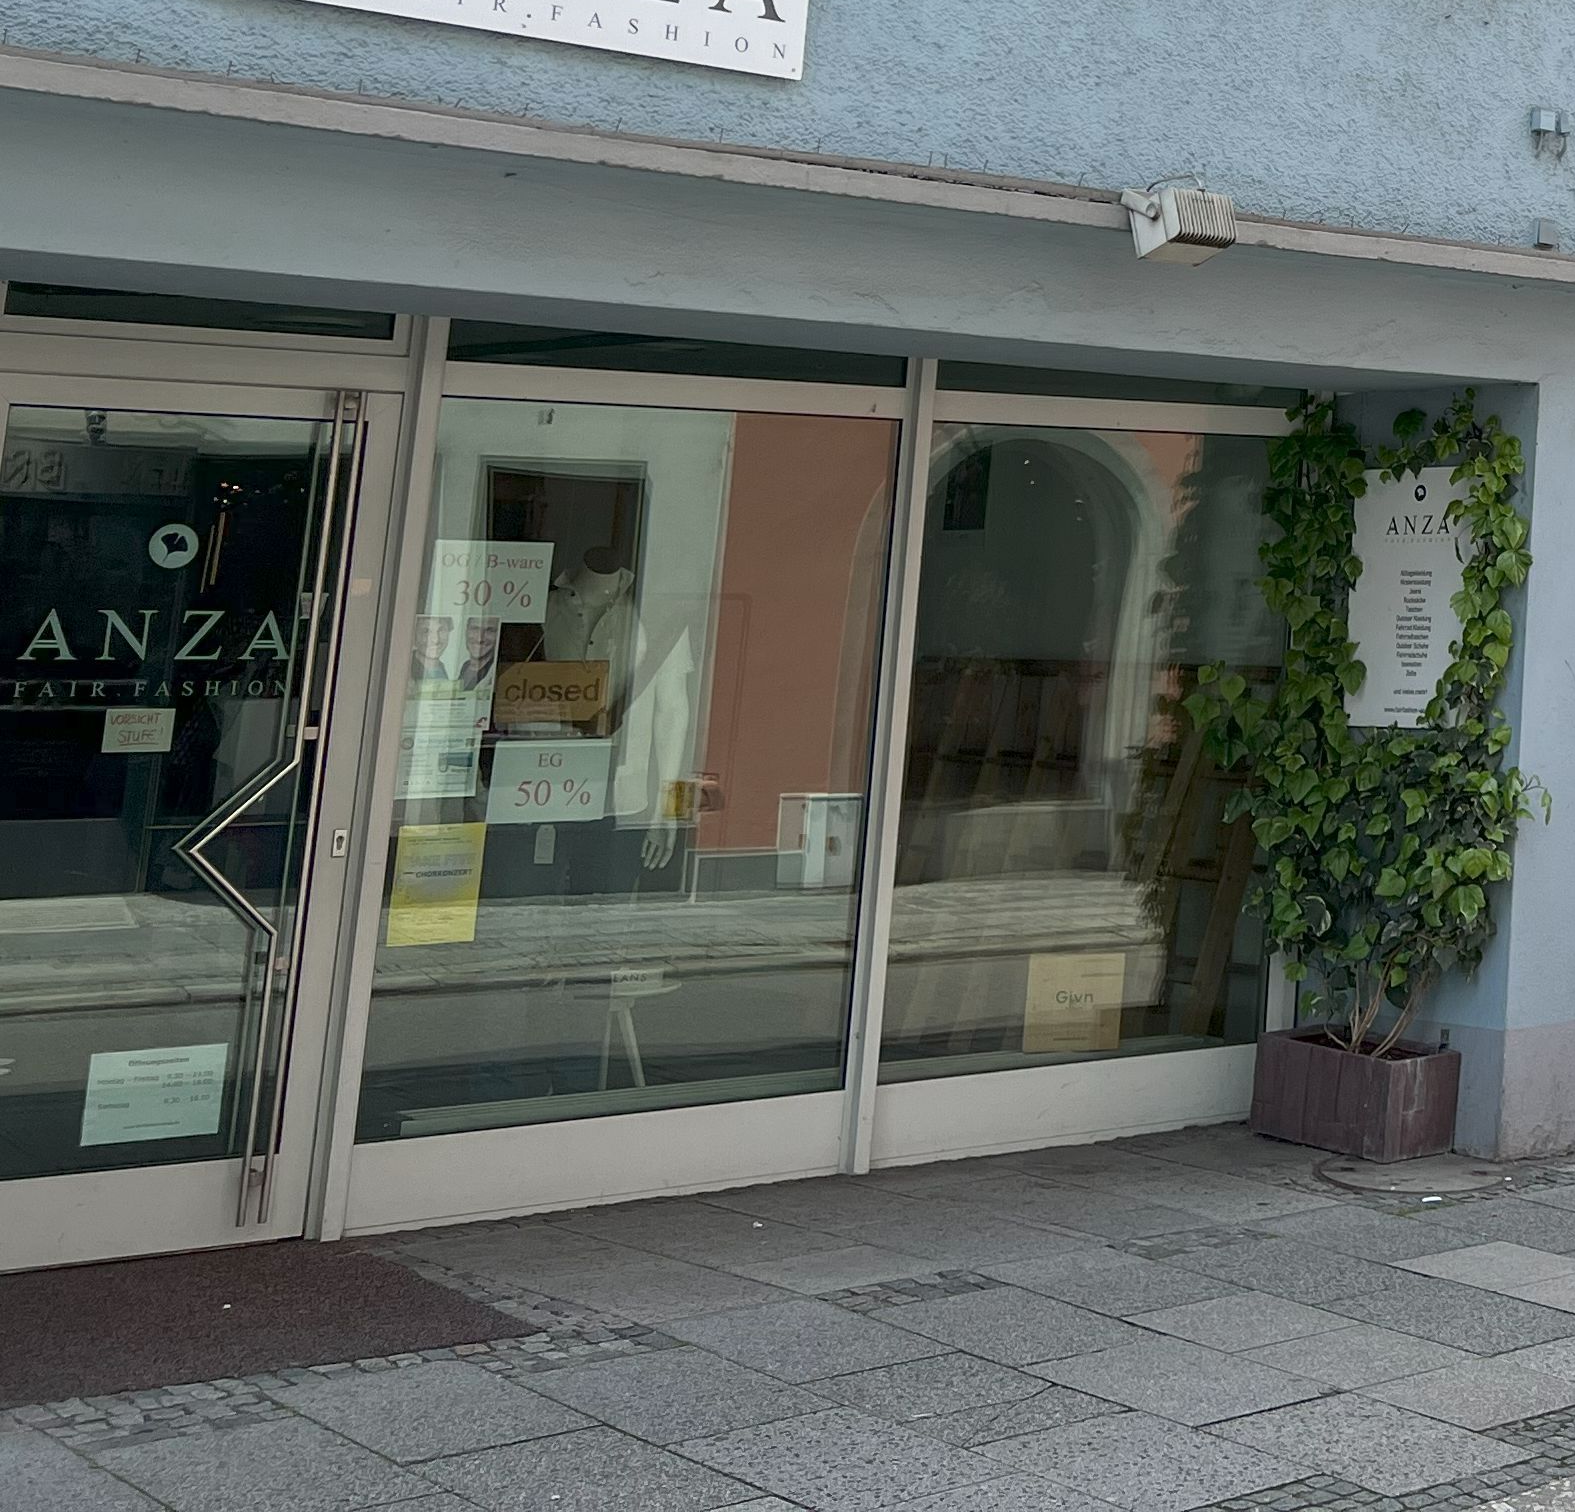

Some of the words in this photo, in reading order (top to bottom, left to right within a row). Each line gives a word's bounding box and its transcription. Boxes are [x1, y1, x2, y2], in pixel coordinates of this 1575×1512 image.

[1386, 515, 1450, 535] ANZA
[486, 554, 545, 569] B-ware
[453, 580, 493, 607] 30
[503, 580, 532, 608] %
[16, 608, 290, 661] ANZA
[504, 678, 600, 702] closed
[110, 712, 162, 726] VORSICHT
[538, 753, 563, 768] EG
[514, 779, 551, 807] 50
[564, 778, 591, 806] %
[1056, 990, 1094, 1003] Givn
